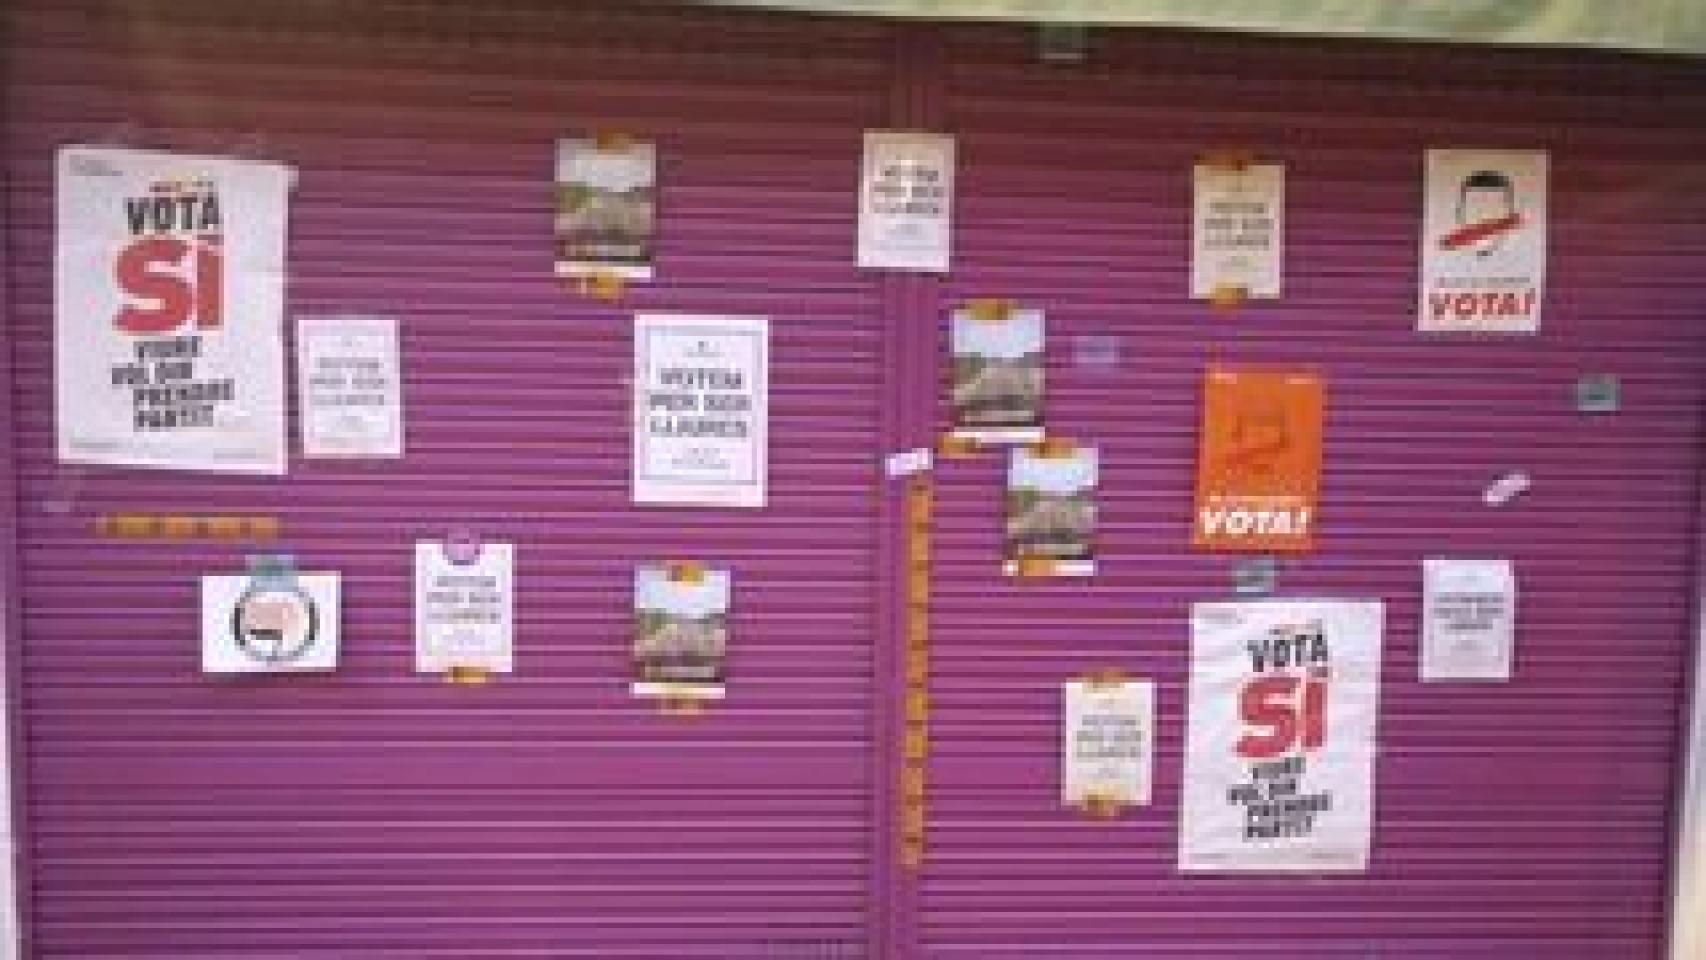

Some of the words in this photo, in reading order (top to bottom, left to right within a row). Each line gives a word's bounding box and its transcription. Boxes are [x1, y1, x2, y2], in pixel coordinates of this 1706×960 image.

[126, 193, 221, 235] VOTA
[1429, 288, 1536, 320] VOTA!
[1200, 507, 1312, 536] VOTA!
[1246, 632, 1330, 672] VOTA
